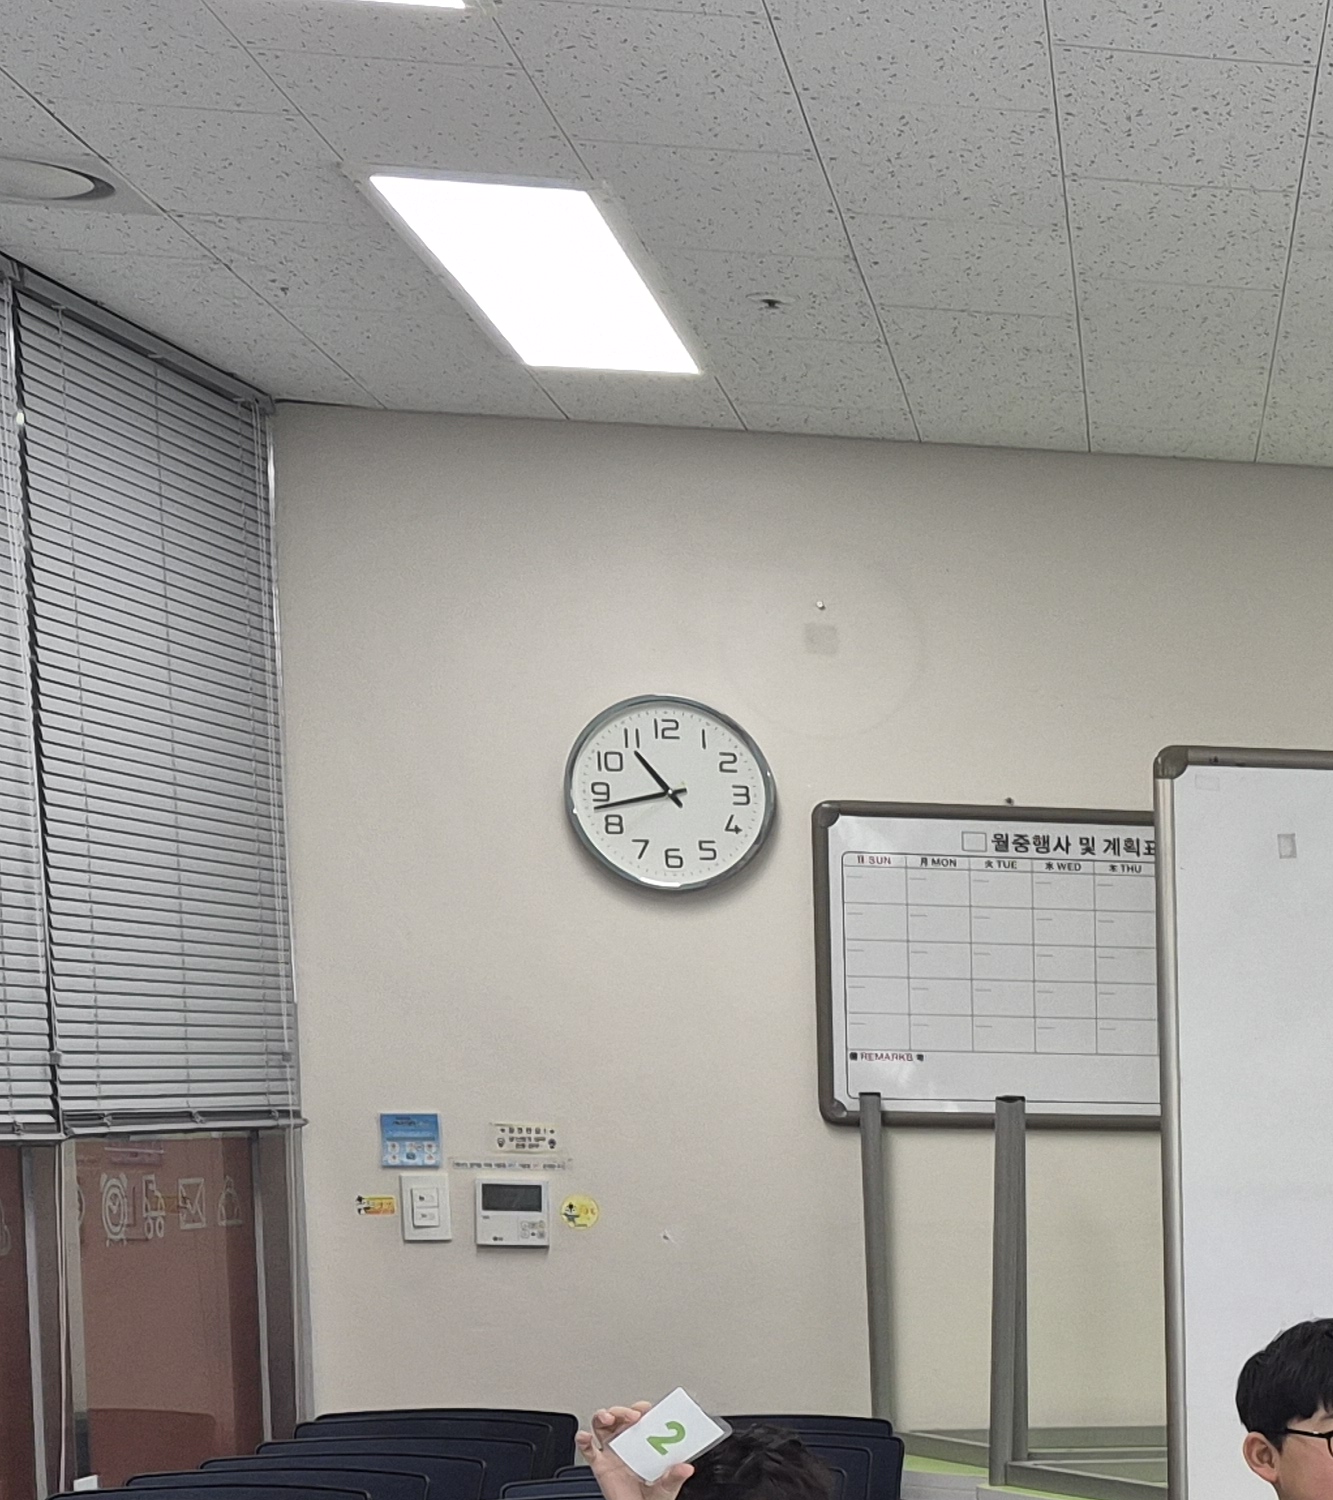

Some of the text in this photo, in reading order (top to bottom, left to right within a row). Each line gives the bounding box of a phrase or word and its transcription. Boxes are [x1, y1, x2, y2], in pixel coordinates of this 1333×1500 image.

[624, 728, 640, 748] 11
[654, 718, 680, 739] 12
[701, 729, 706, 749] 1
[597, 751, 623, 772] 10
[719, 752, 738, 773] 2
[591, 782, 610, 802] 9
[732, 785, 750, 805] 3
[605, 814, 624, 834] 8
[725, 814, 742, 834] 4
[632, 839, 649, 859] 7
[698, 840, 717, 860] 5
[992, 833, 1071, 854] 월중행사
[1079, 836, 1096, 855] 및
[665, 848, 683, 868] 6
[868, 856, 891, 865] SUN
[931, 858, 957, 867] MON
[997, 860, 1017, 869] TUE
[1057, 862, 1082, 872] WED
[1121, 864, 1142, 873] THU
[646, 1420, 686, 1456] 2
